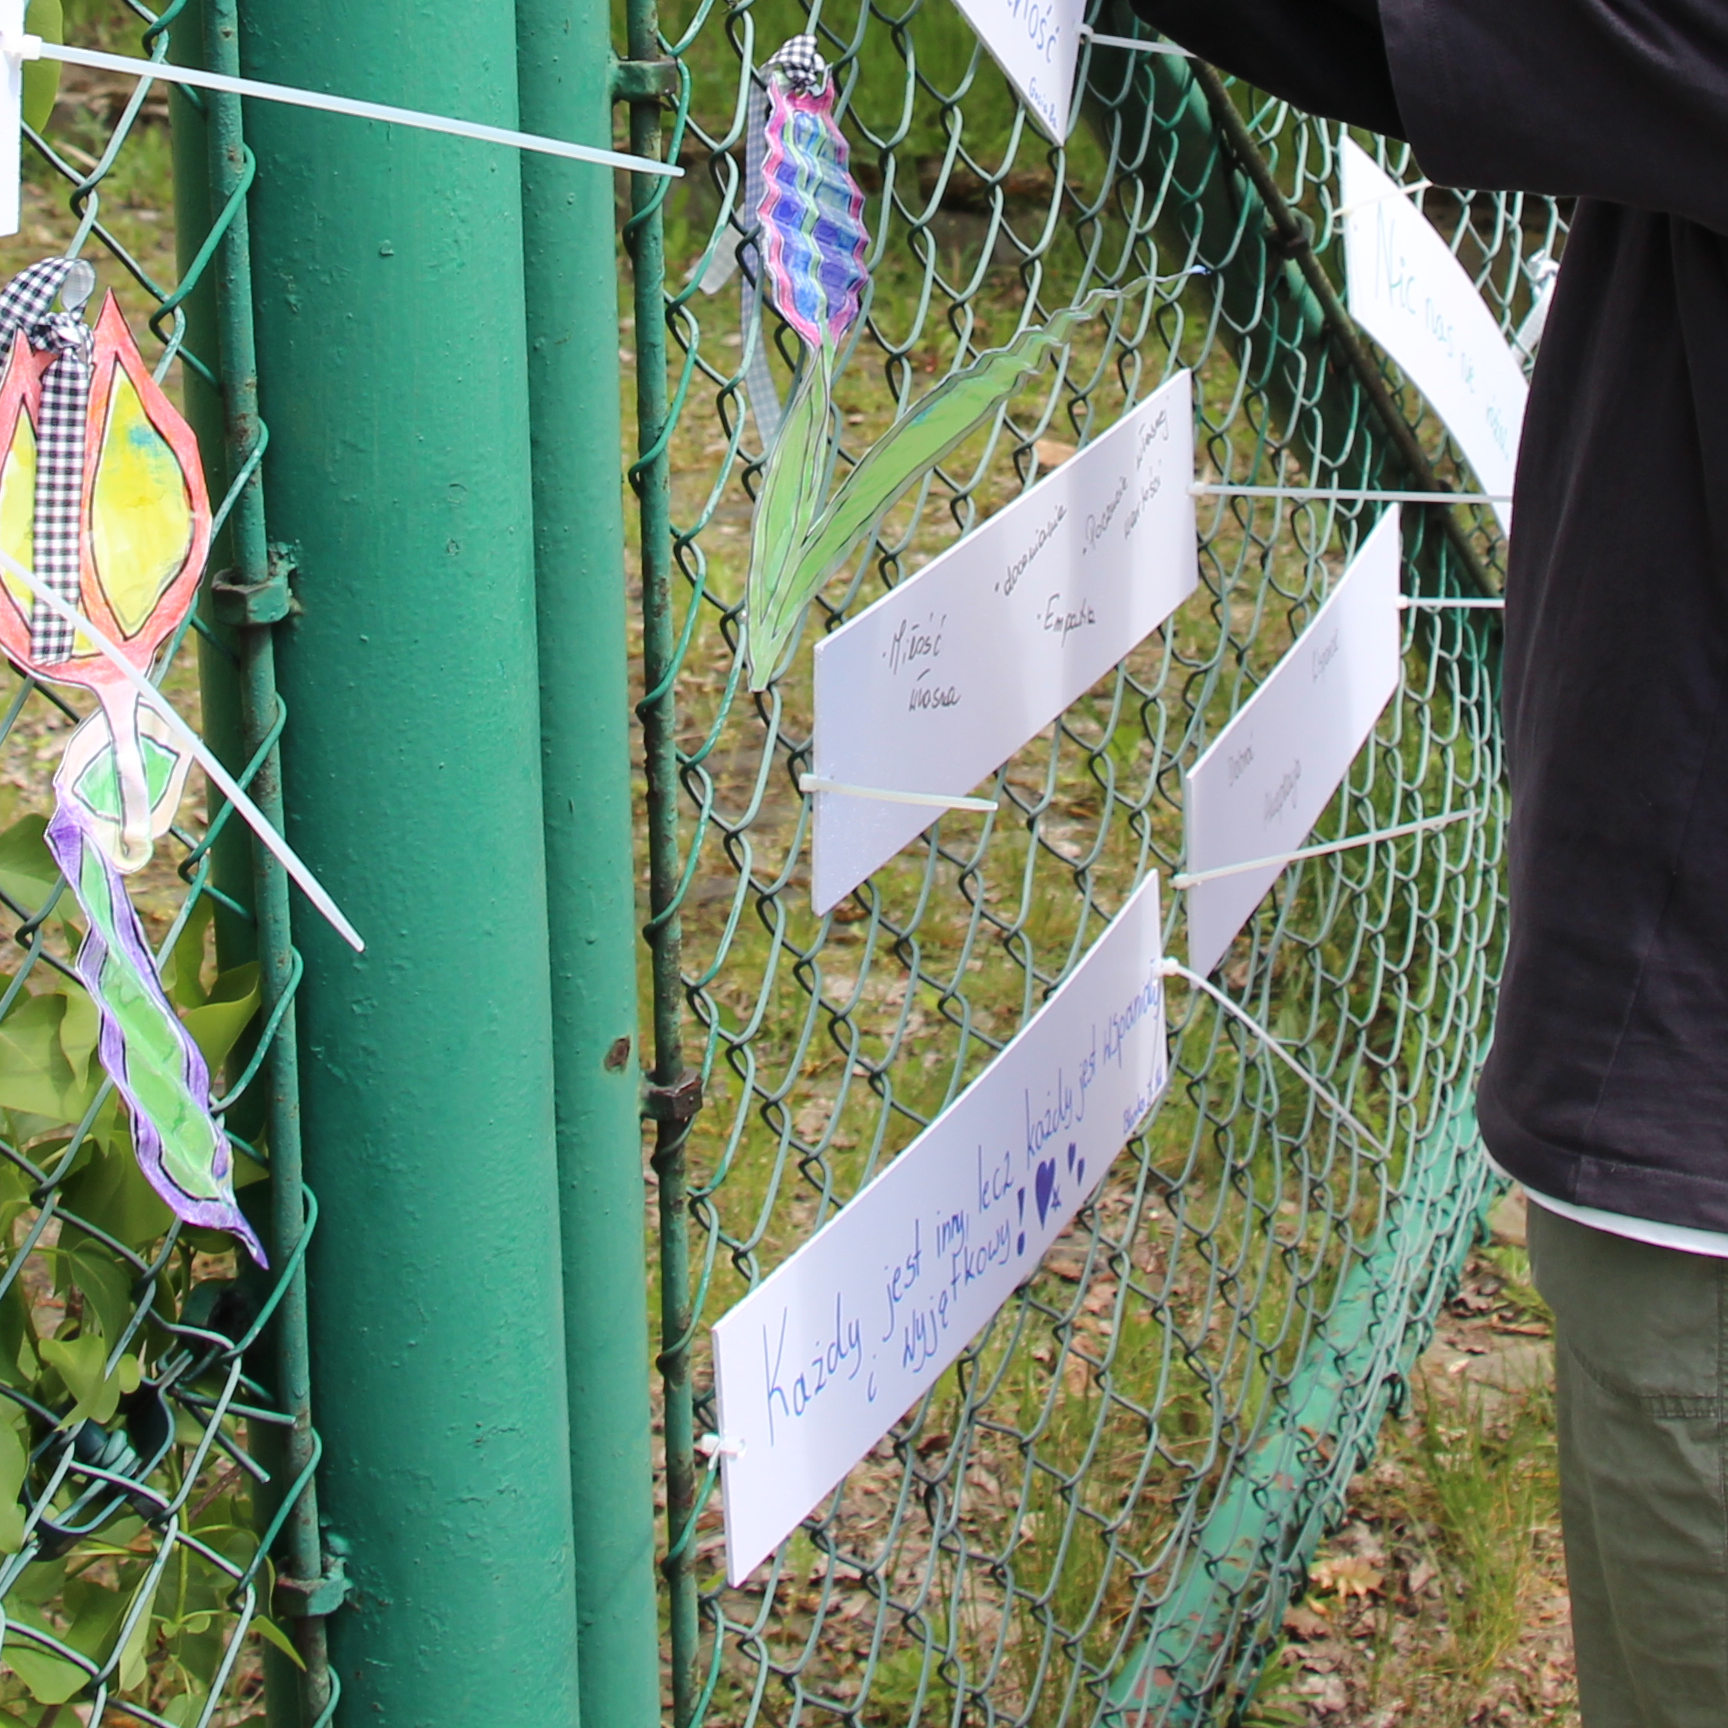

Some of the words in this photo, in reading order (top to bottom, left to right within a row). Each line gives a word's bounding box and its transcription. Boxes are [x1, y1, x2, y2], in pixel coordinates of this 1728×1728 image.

[1377, 201, 1417, 315] Nic
[1425, 298, 1455, 358] nas
[890, 613, 947, 676] Miłość
[763, 1292, 863, 1448] Każdy
[883, 1219, 922, 1343] jest
[978, 1144, 1014, 1218] lecz
[1024, 1088, 1073, 1172] każdy
[1076, 1024, 1097, 1122] jest
[867, 1355, 878, 1404] i
